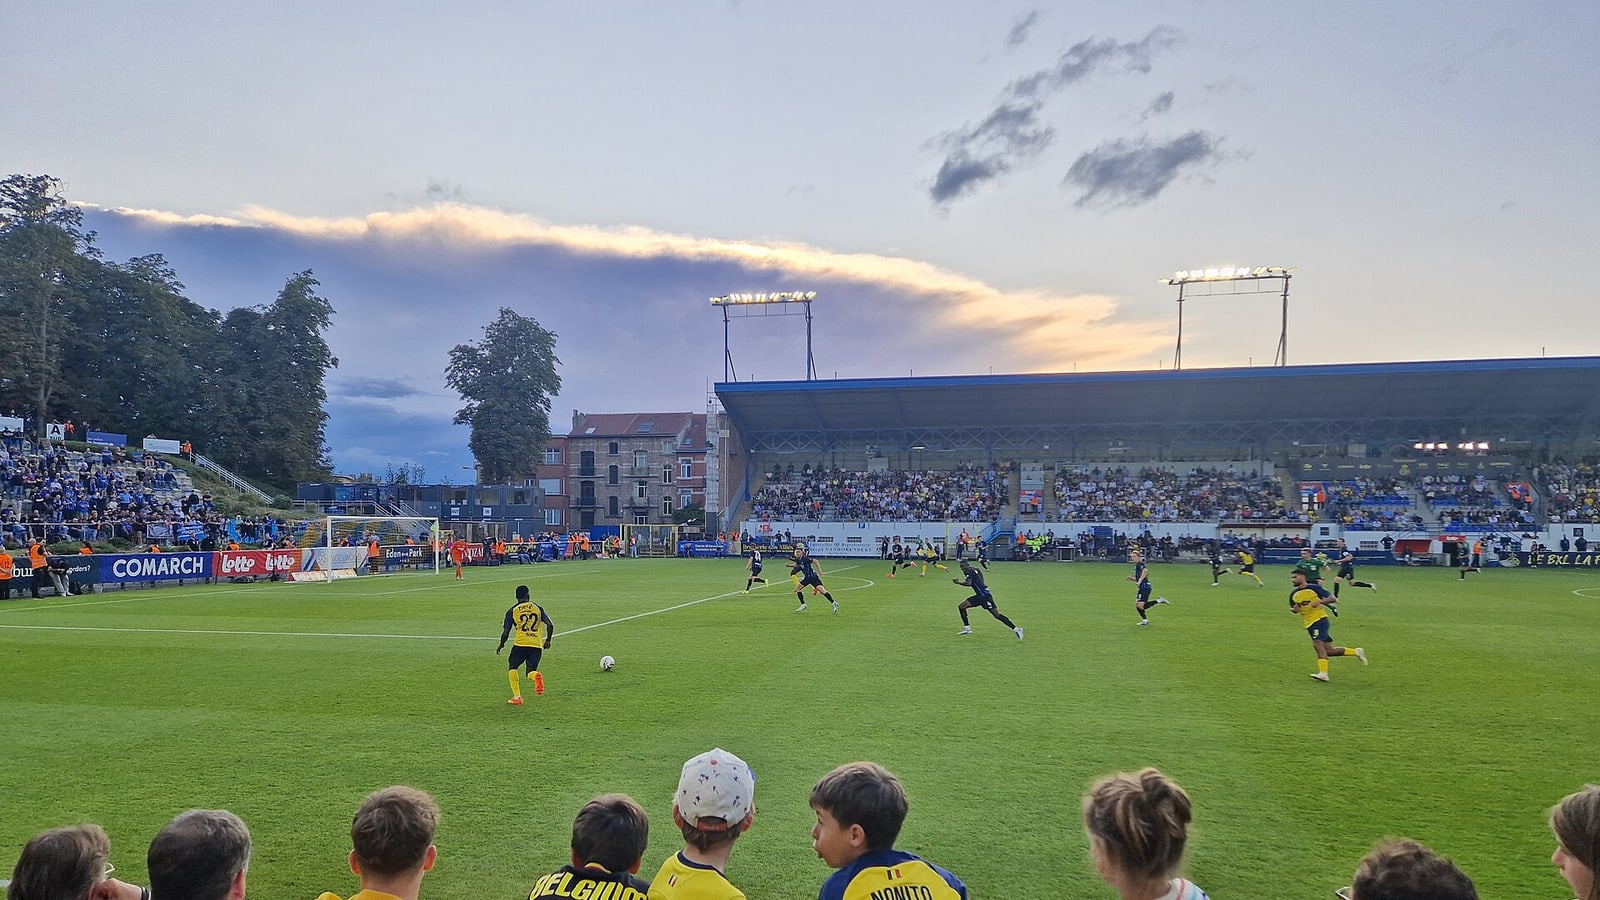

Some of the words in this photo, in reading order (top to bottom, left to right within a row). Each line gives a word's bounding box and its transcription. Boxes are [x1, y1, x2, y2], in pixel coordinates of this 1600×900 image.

[51, 425, 60, 434] A
[386, 548, 402, 558] Eden
[409, 547, 423, 557] Park
[1547, 554, 1570, 565] BXL
[1574, 554, 1592, 565] LA
[113, 556, 203, 577] COMARCH
[222, 554, 255, 573] Lotto
[265, 554, 295, 571] Lotto
[519, 613, 538, 632] 22
[870, 885, 933, 900] NONITO
